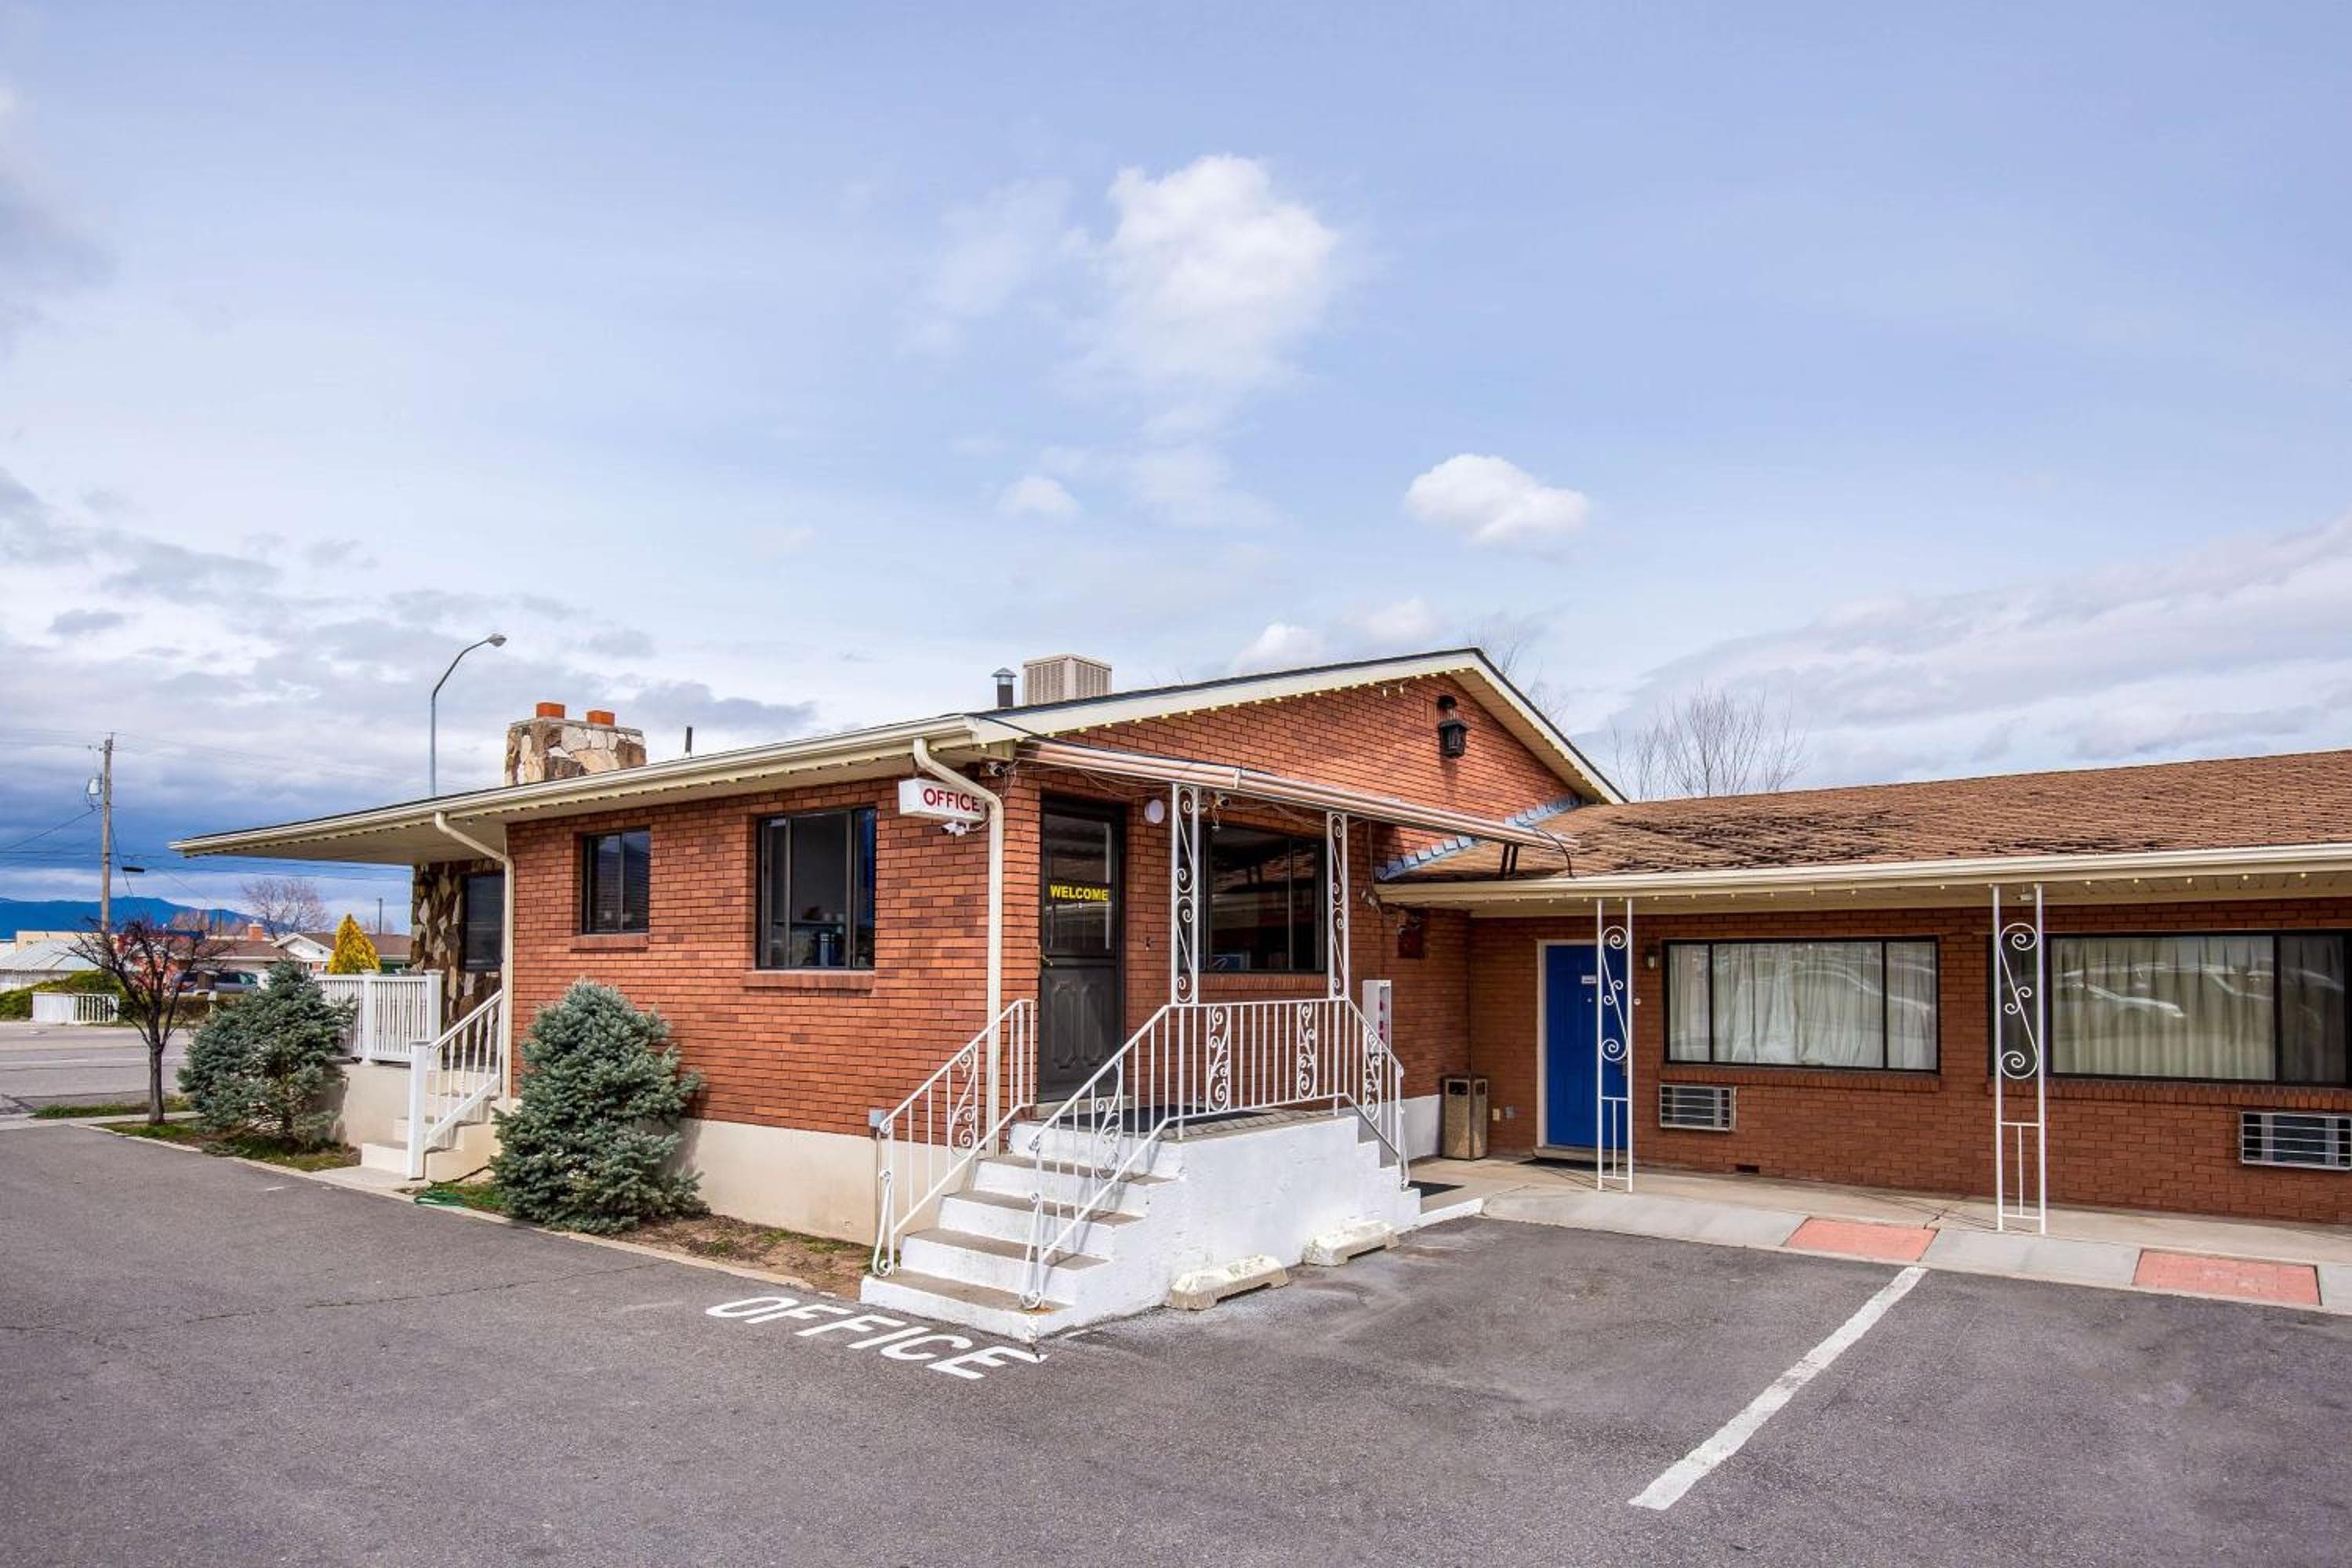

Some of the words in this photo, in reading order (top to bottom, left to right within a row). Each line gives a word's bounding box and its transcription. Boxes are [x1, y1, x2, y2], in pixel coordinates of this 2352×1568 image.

[924, 788, 980, 812] OFFICE
[1050, 884, 1109, 901] WELCOME
[705, 1296, 1048, 1379] OFFICE
